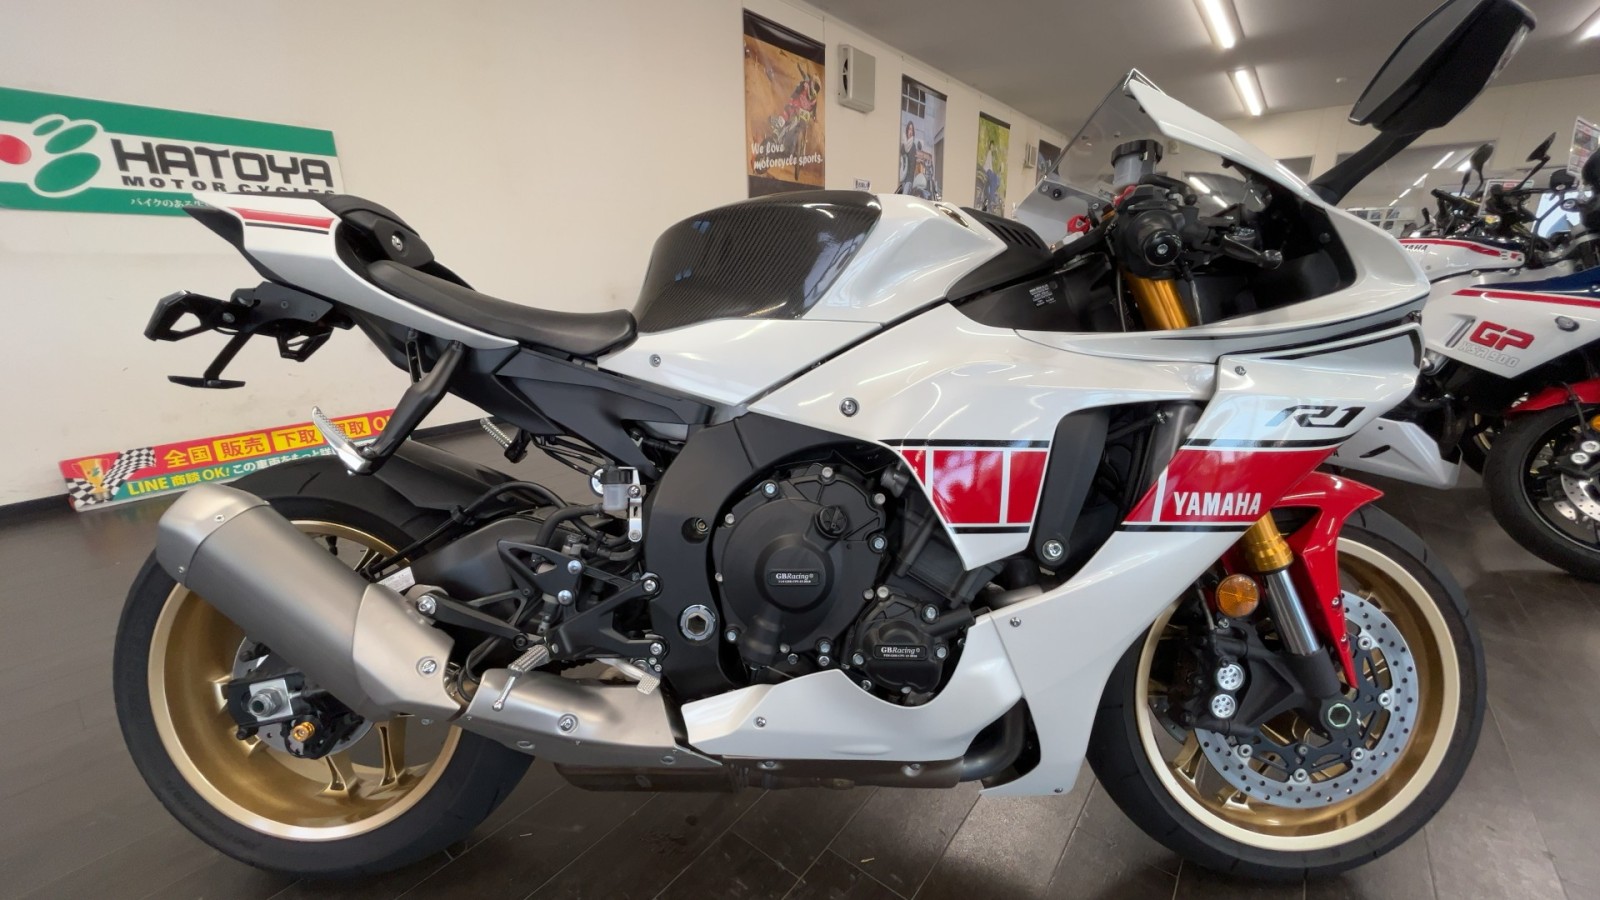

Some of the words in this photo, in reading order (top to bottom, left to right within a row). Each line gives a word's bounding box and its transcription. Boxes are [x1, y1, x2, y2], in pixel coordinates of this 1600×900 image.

[751, 142, 764, 154] We
[766, 141, 785, 154] love
[110, 138, 334, 187] HATOYA
[754, 154, 797, 170] motorcycle
[799, 152, 823, 166] sports.
[121, 175, 228, 193] MOTOR
[1469, 320, 1535, 351] GP
[1457, 341, 1521, 368] XSR900
[1264, 404, 1366, 428] R1
[163, 445, 213, 468] 全国
[221, 436, 265, 458] 販売
[278, 428, 318, 447] 下取
[372, 415, 390, 431] O
[127, 477, 169, 495] LINE
[171, 472, 201, 487] 商談
[202, 466, 230, 480] OK!
[1173, 491, 1262, 516] YAMAHA
